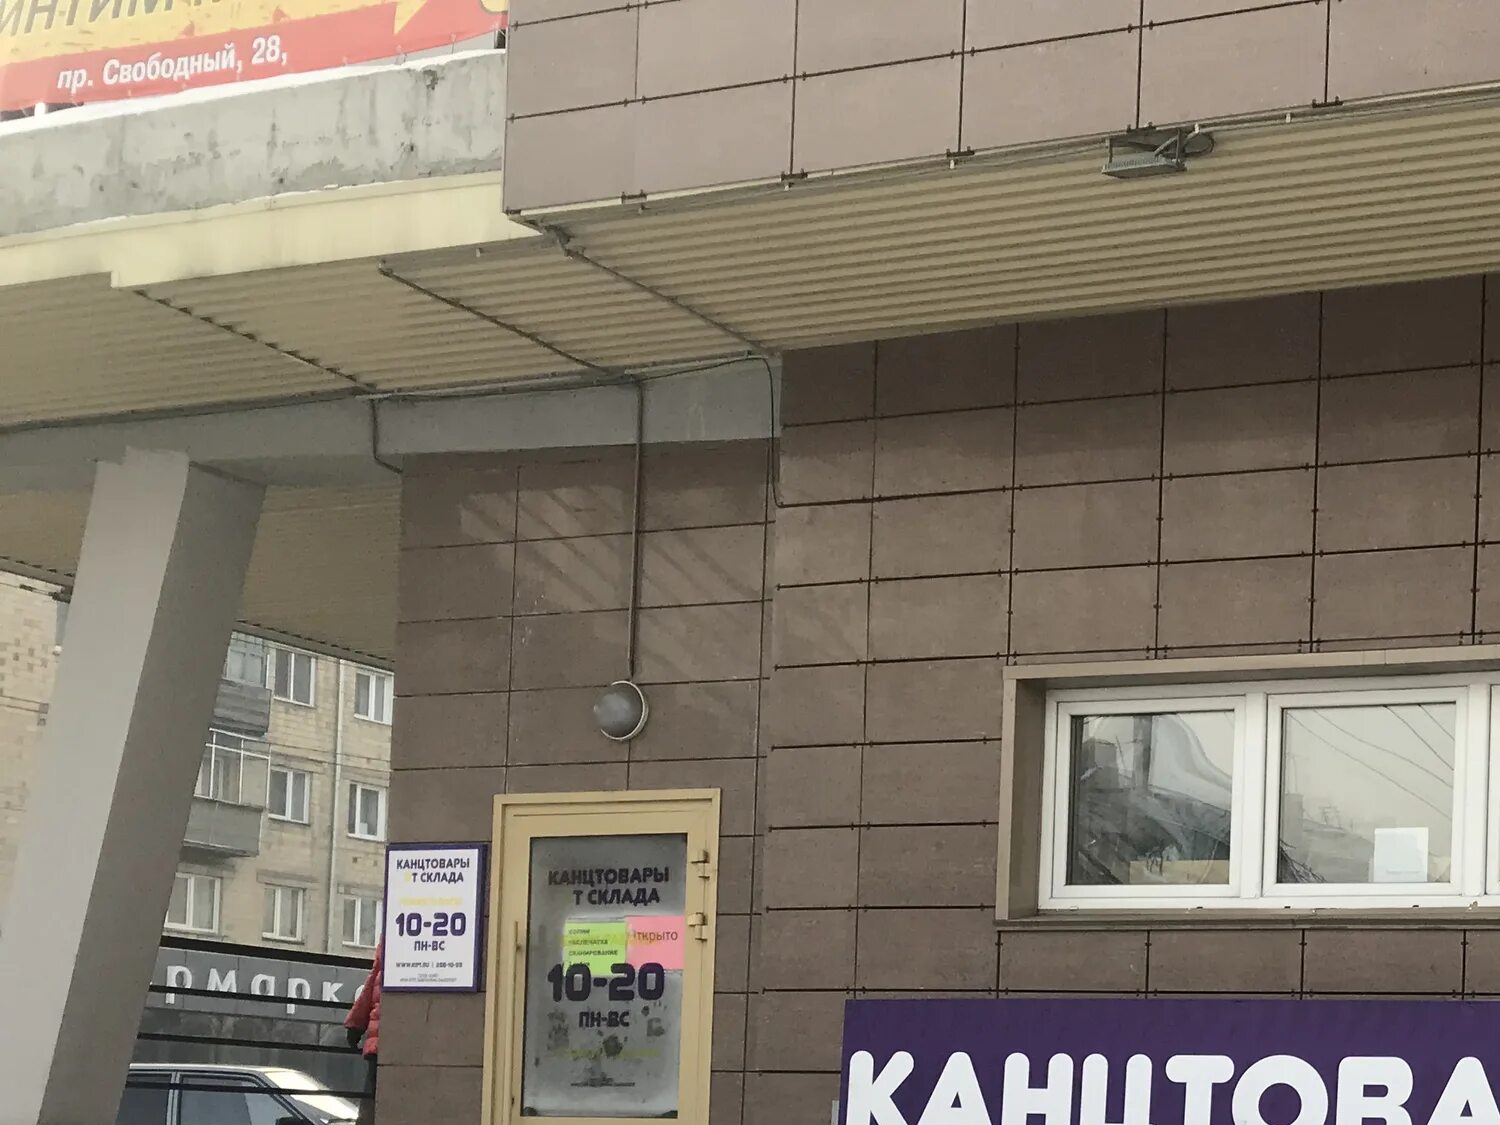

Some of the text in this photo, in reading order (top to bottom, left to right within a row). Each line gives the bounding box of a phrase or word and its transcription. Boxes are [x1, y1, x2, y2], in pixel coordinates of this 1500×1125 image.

[57, 35, 288, 93] пр. Свободный, 28,
[396, 858, 470, 871] КАНЦТОВАРЫ
[420, 872, 464, 884] СКЛАДА
[548, 867, 669, 887] КАНЦТОВАРЫ
[587, 888, 660, 906] СКЛАДА
[395, 912, 466, 937] 10-20
[414, 940, 445, 951] ПН-ВС
[150, 965, 365, 1015] рмарк
[547, 962, 665, 1002] 10-20
[578, 1010, 629, 1028] ПН-ВС
